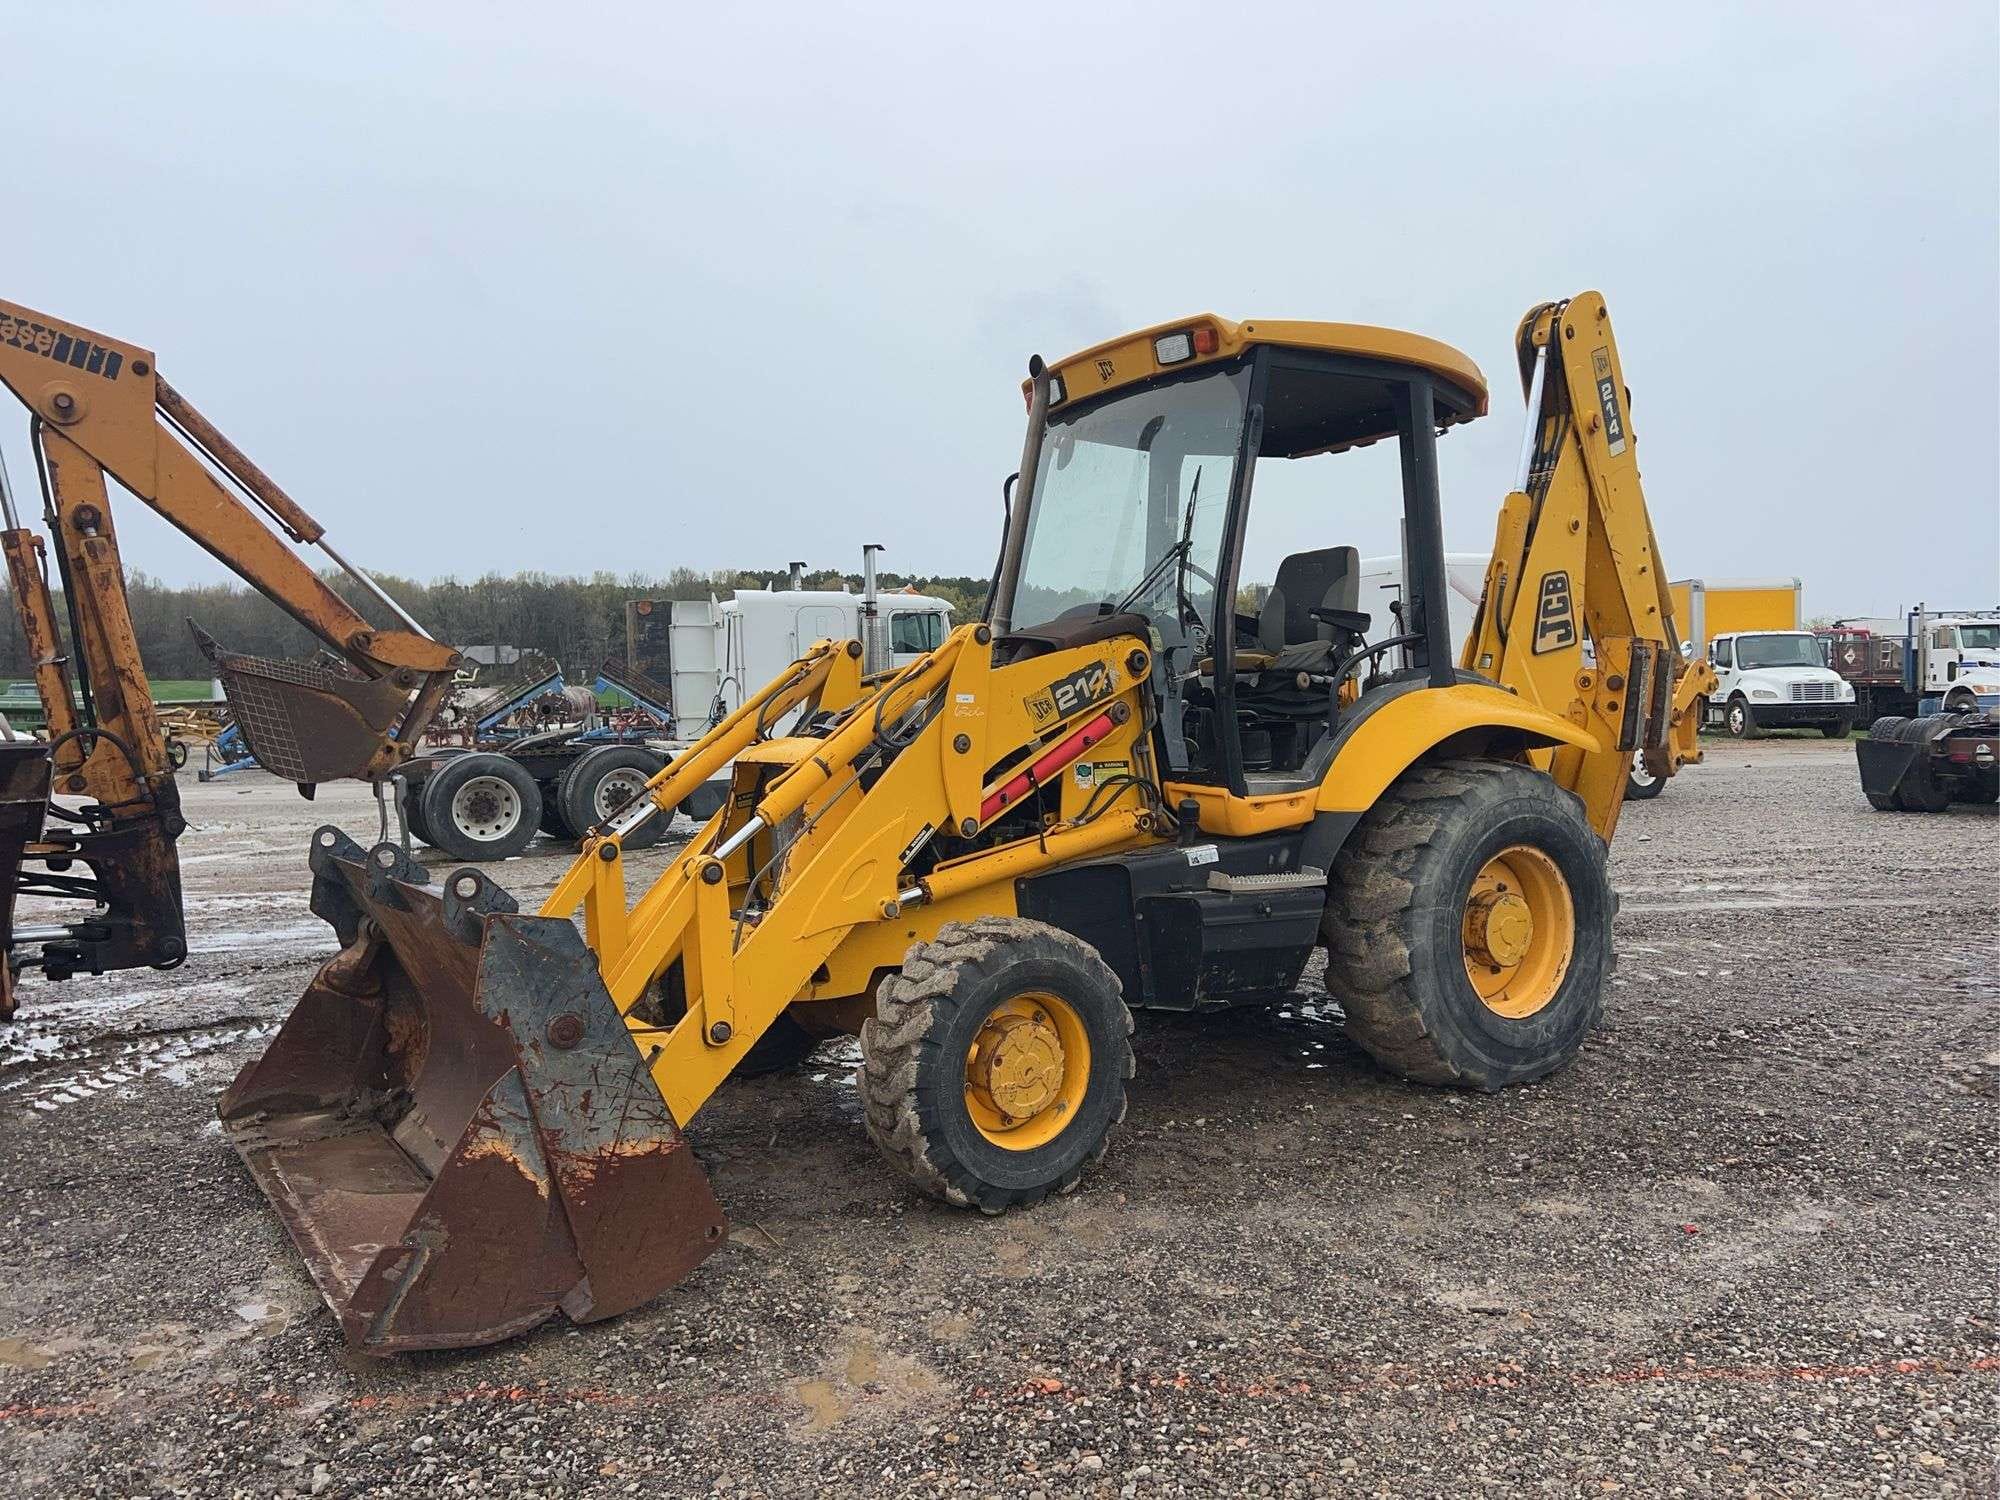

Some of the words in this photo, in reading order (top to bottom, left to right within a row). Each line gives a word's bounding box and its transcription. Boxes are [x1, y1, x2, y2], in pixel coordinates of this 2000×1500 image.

[1601, 382, 1620, 435] 214
[1539, 576, 1573, 643] JCB
[1032, 699, 1054, 720] JCB
[1055, 667, 1112, 711] 214
